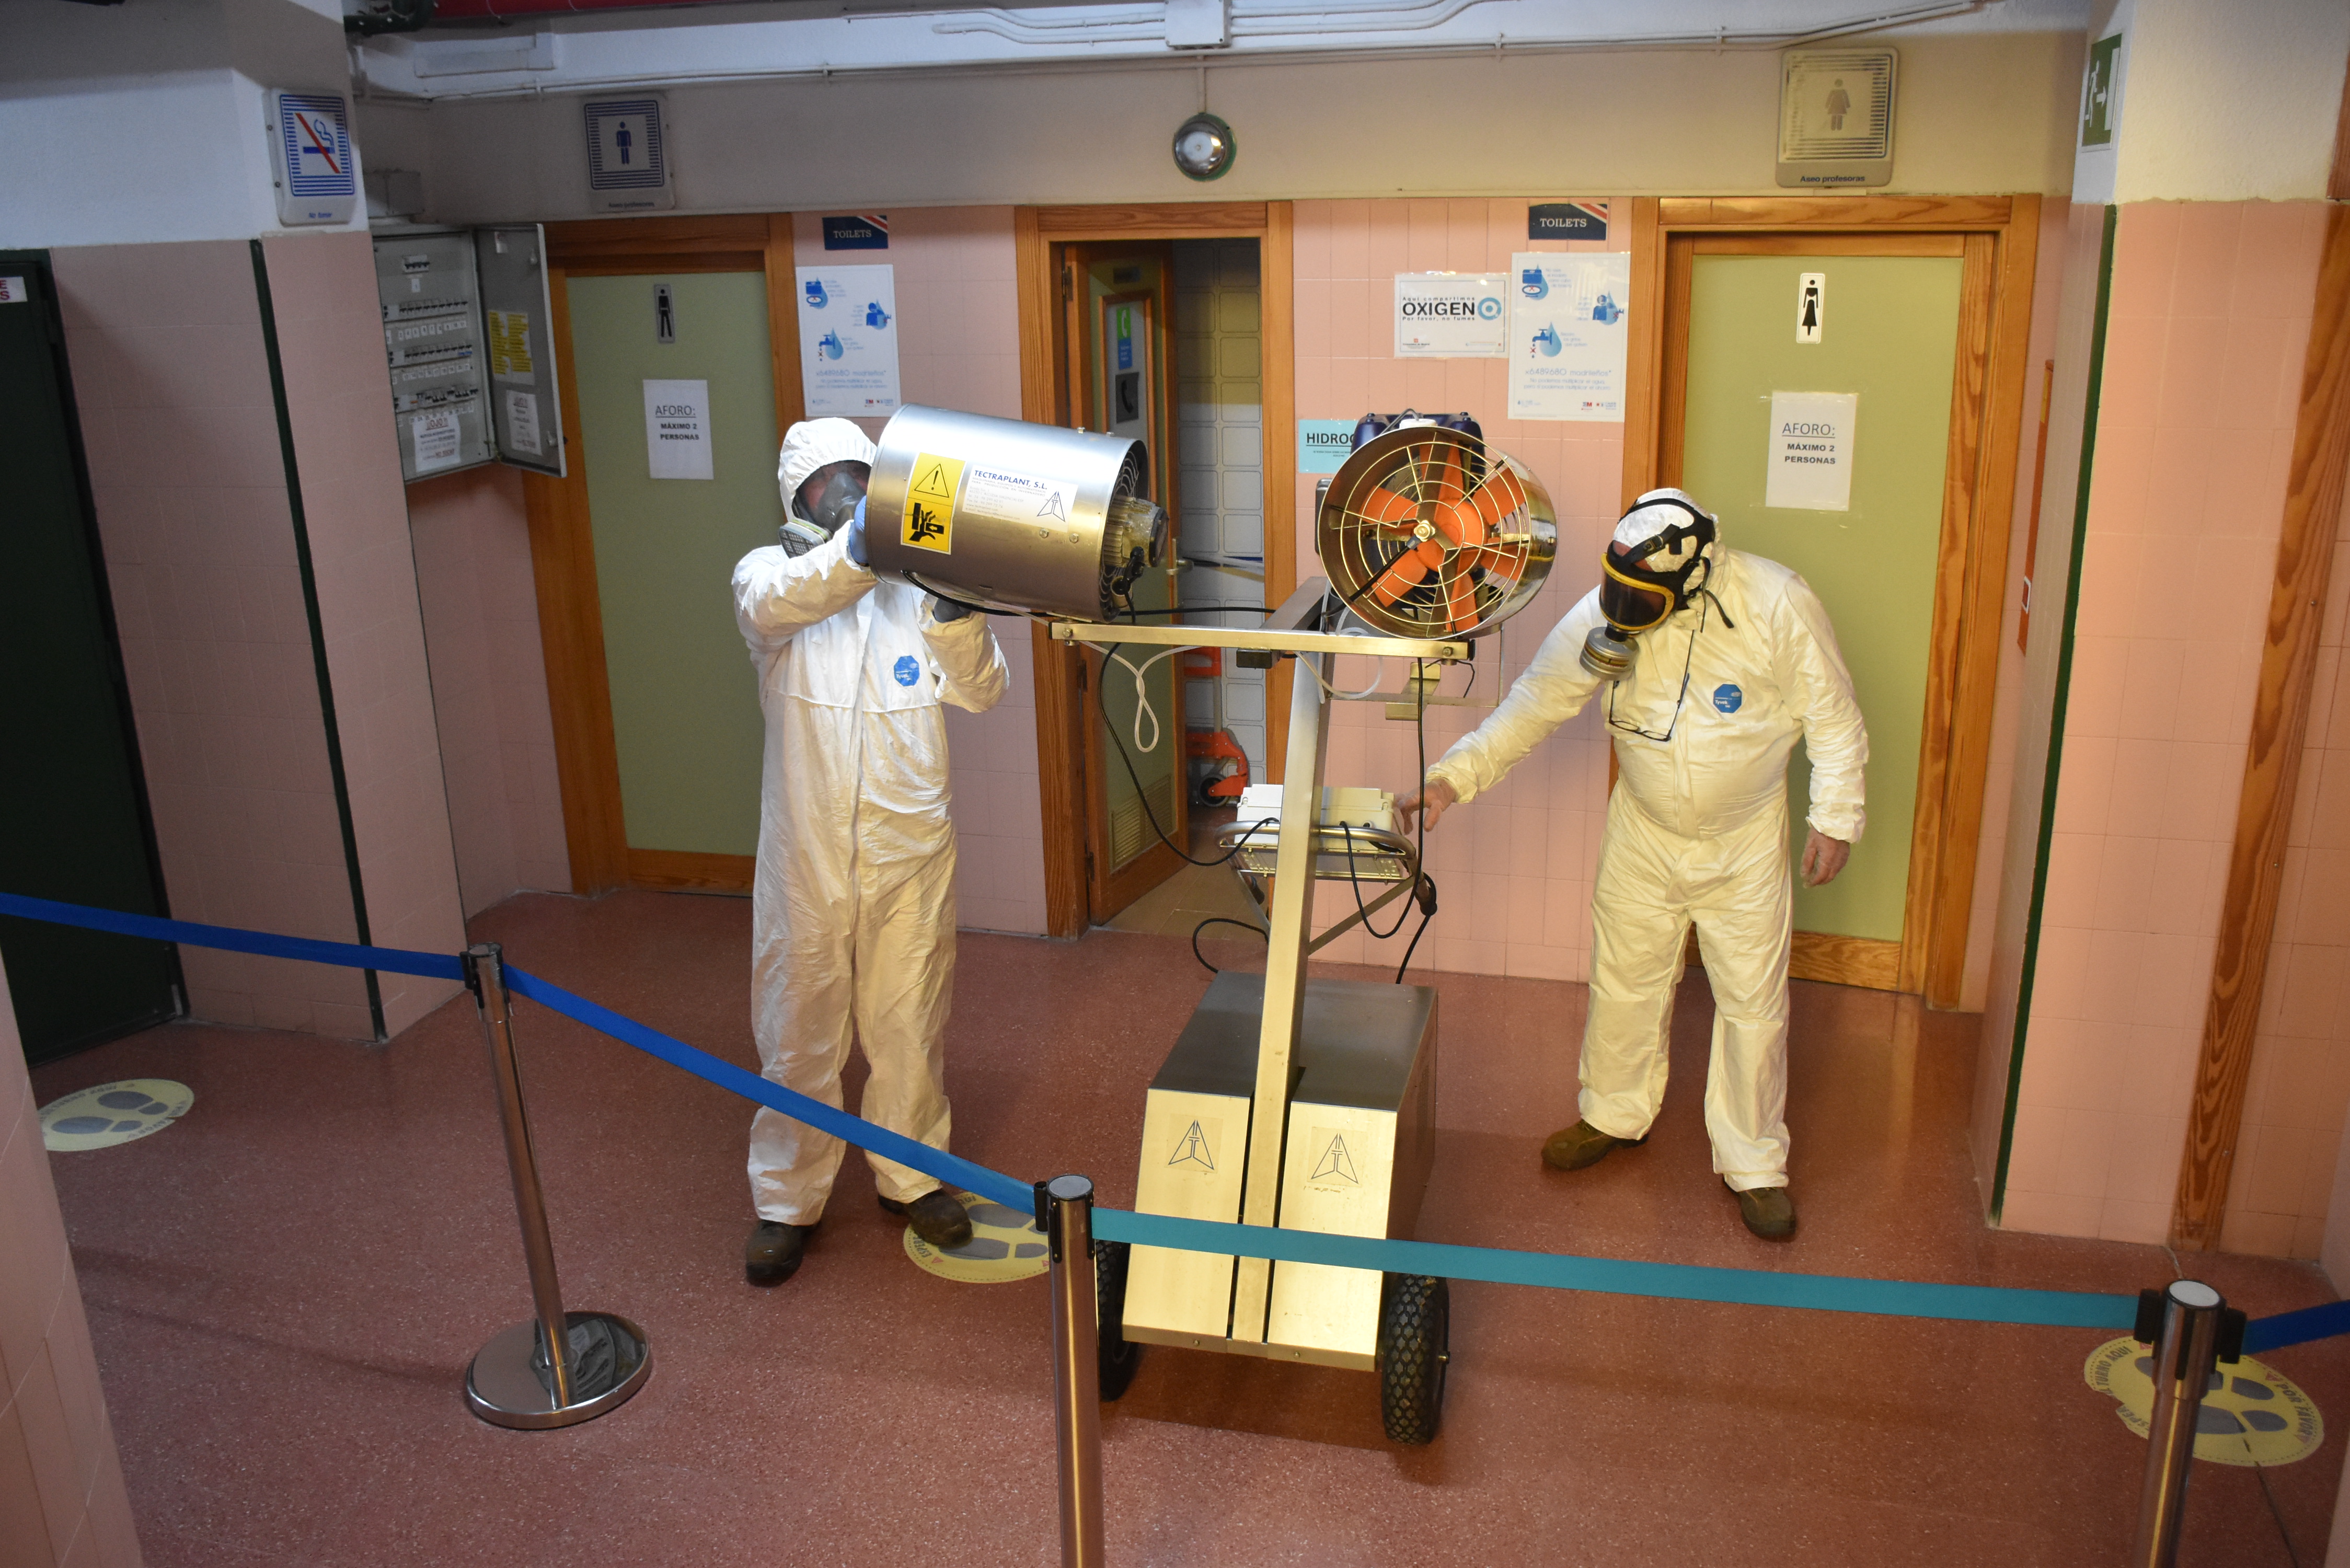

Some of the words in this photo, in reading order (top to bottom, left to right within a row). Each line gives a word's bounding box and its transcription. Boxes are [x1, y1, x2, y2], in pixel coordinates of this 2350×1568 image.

[1822, 175, 1865, 183] profesoras
[1540, 218, 1587, 228] TOILETS
[834, 229, 872, 239] TOILETS
[655, 405, 696, 416] AFORO:
[1782, 422, 1835, 436] AFORO:
[1787, 442, 1826, 452] MÁXIMO
[1784, 456, 1836, 465] PERSONAS
[975, 470, 1031, 487] TECTRAPLANT,
[1034, 481, 1047, 490] S.L.
[2274, 1382, 2302, 1403] POR
